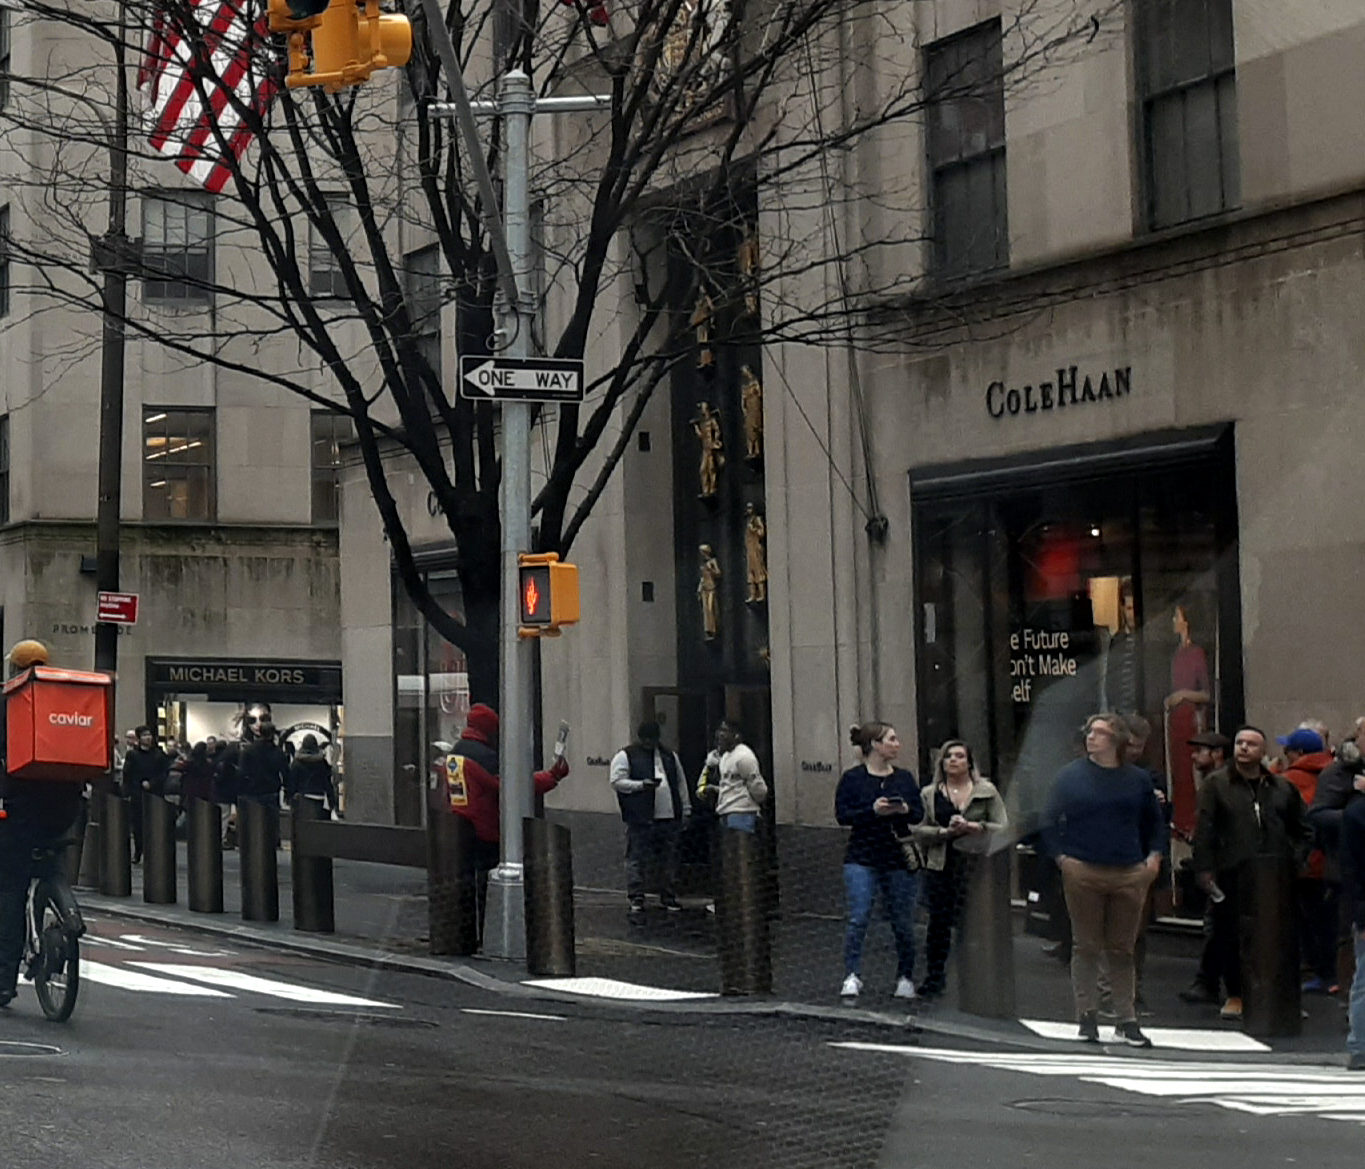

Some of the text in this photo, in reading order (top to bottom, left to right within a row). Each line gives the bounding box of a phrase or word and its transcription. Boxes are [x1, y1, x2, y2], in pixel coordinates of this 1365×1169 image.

[478, 369, 574, 389] ONE WAY
[1023, 629, 1070, 650] Future
[1038, 652, 1077, 676] Make
[169, 666, 305, 684] MICHAEL KORS
[1011, 678, 1032, 702] elf
[48, 711, 93, 727] caviar
